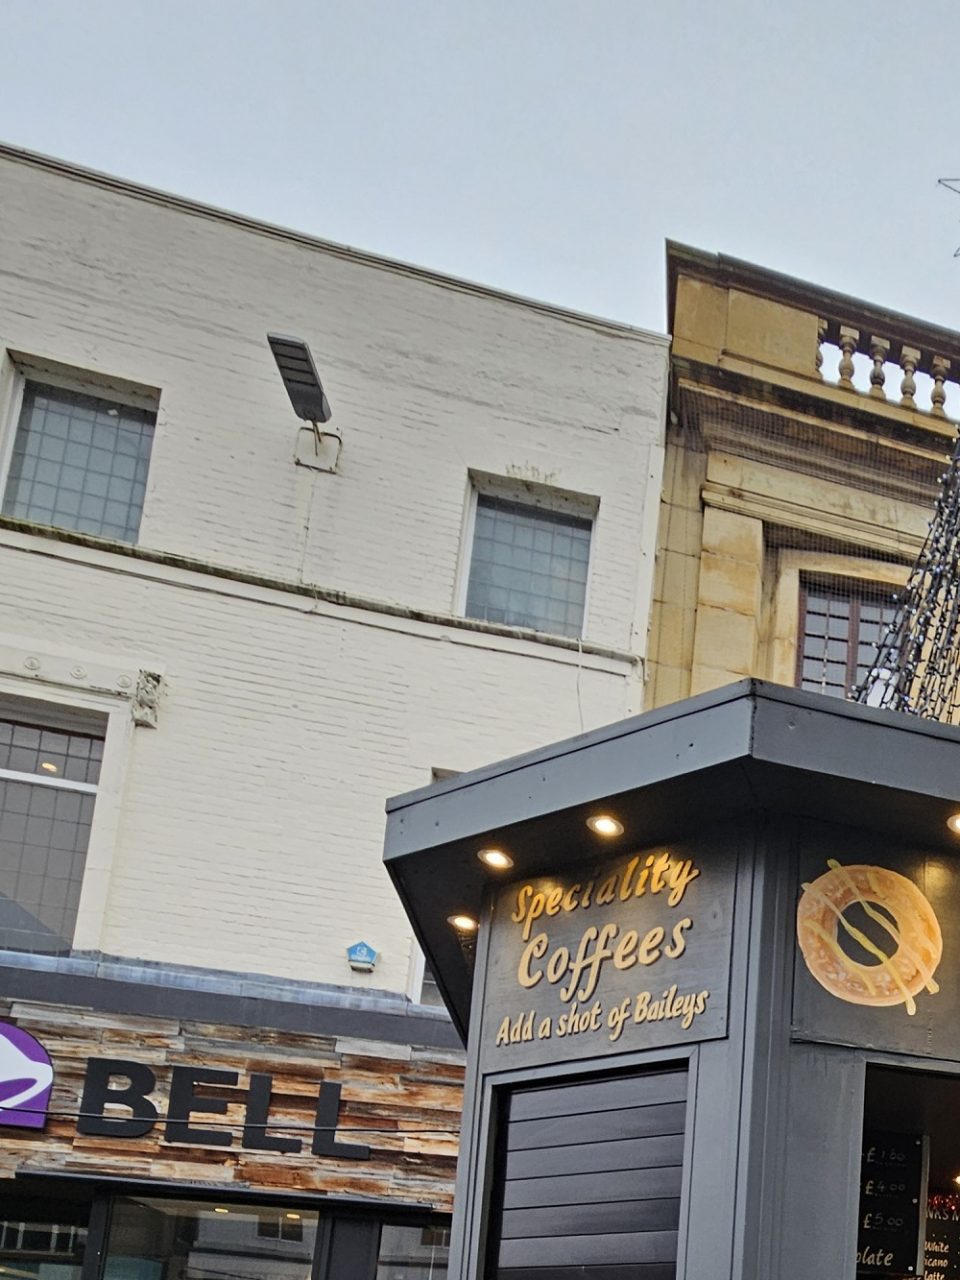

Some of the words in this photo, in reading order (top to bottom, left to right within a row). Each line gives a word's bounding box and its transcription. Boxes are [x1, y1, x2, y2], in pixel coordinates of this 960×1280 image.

[511, 853, 700, 941] Speciality
[517, 918, 692, 1003] Coffees
[496, 1010, 535, 1046] Add
[538, 1017, 552, 1039] a
[556, 1002, 601, 1037] shot
[608, 998, 631, 1041] of
[634, 984, 709, 1029] Baileys
[76, 1056, 371, 1161] BELL
[857, 1246, 894, 1266] olate
[923, 1255, 949, 1268] icano
